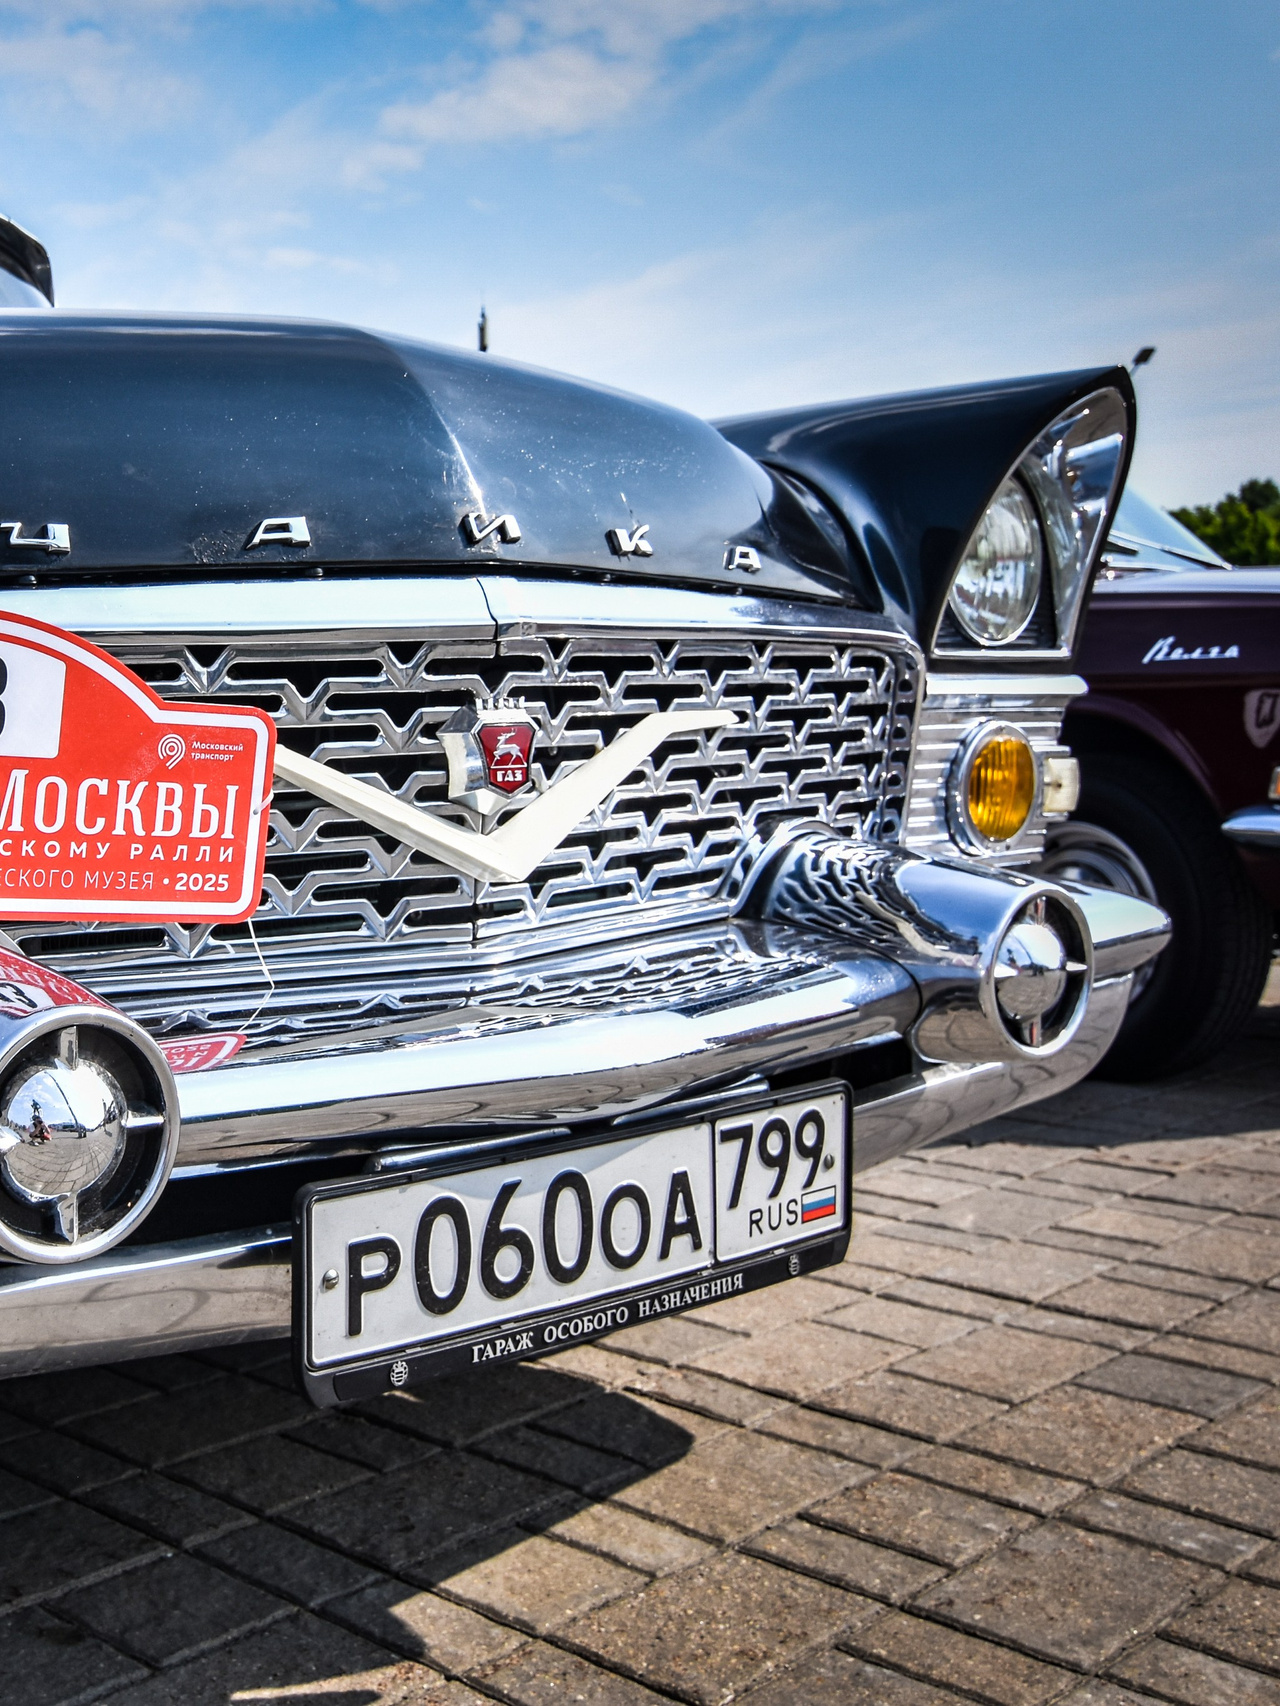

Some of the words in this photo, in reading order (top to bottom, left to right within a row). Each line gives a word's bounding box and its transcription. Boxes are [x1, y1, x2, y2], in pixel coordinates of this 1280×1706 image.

[192, 741, 244, 752] Московский
[191, 752, 235, 763] транспорт
[496, 770, 523, 782] ГАЗ
[129, 843, 234, 863] РАЛЛИ
[83, 870, 154, 890] МУЗЕЯ
[174, 872, 230, 893] 2025
[719, 1106, 826, 1210] 799
[749, 1198, 799, 1238] RUS
[472, 1331, 534, 1363] ГАРАЖ
[543, 1306, 629, 1343] ОСОБОГО
[638, 1273, 744, 1318] НАЗНАЧЕНИЯ
